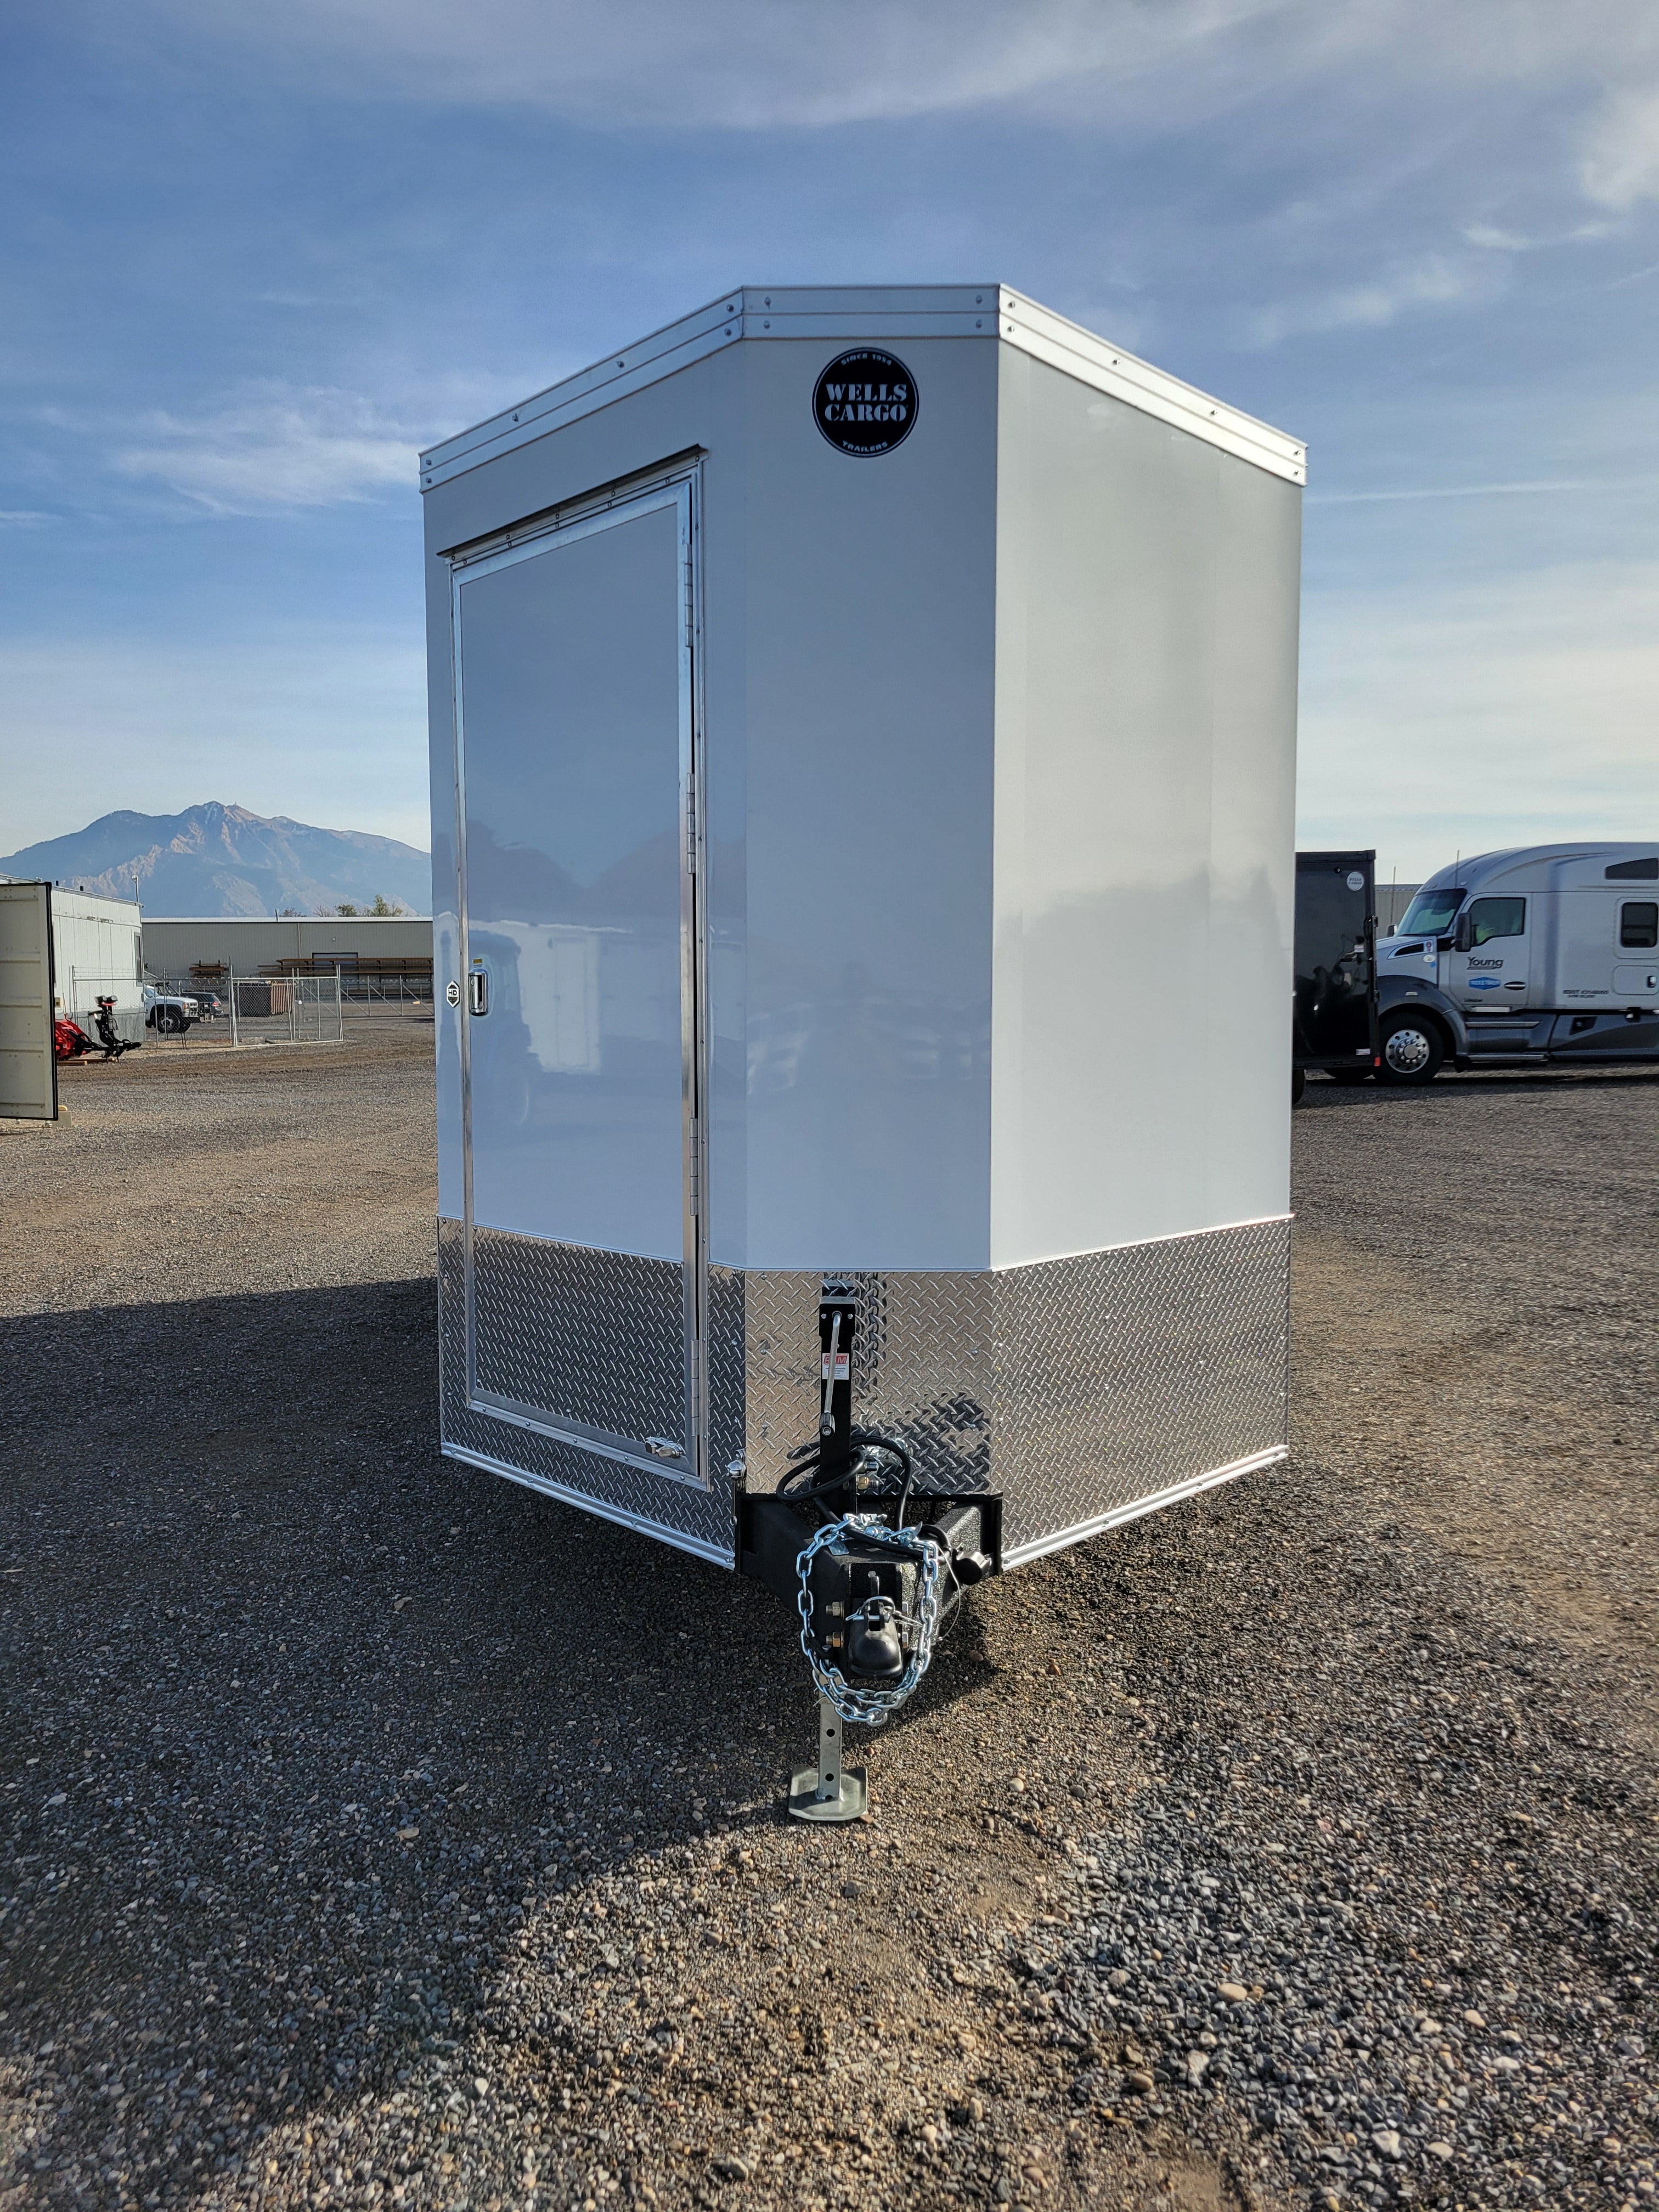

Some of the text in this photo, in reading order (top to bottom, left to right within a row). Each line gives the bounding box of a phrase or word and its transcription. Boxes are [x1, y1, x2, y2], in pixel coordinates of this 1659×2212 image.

[841, 353, 868, 366] SINCE
[825, 383, 907, 402] WELLS
[825, 404, 907, 422] CARGO
[842, 440, 888, 453] TRAILERS
[1467, 956, 1504, 969] Young
